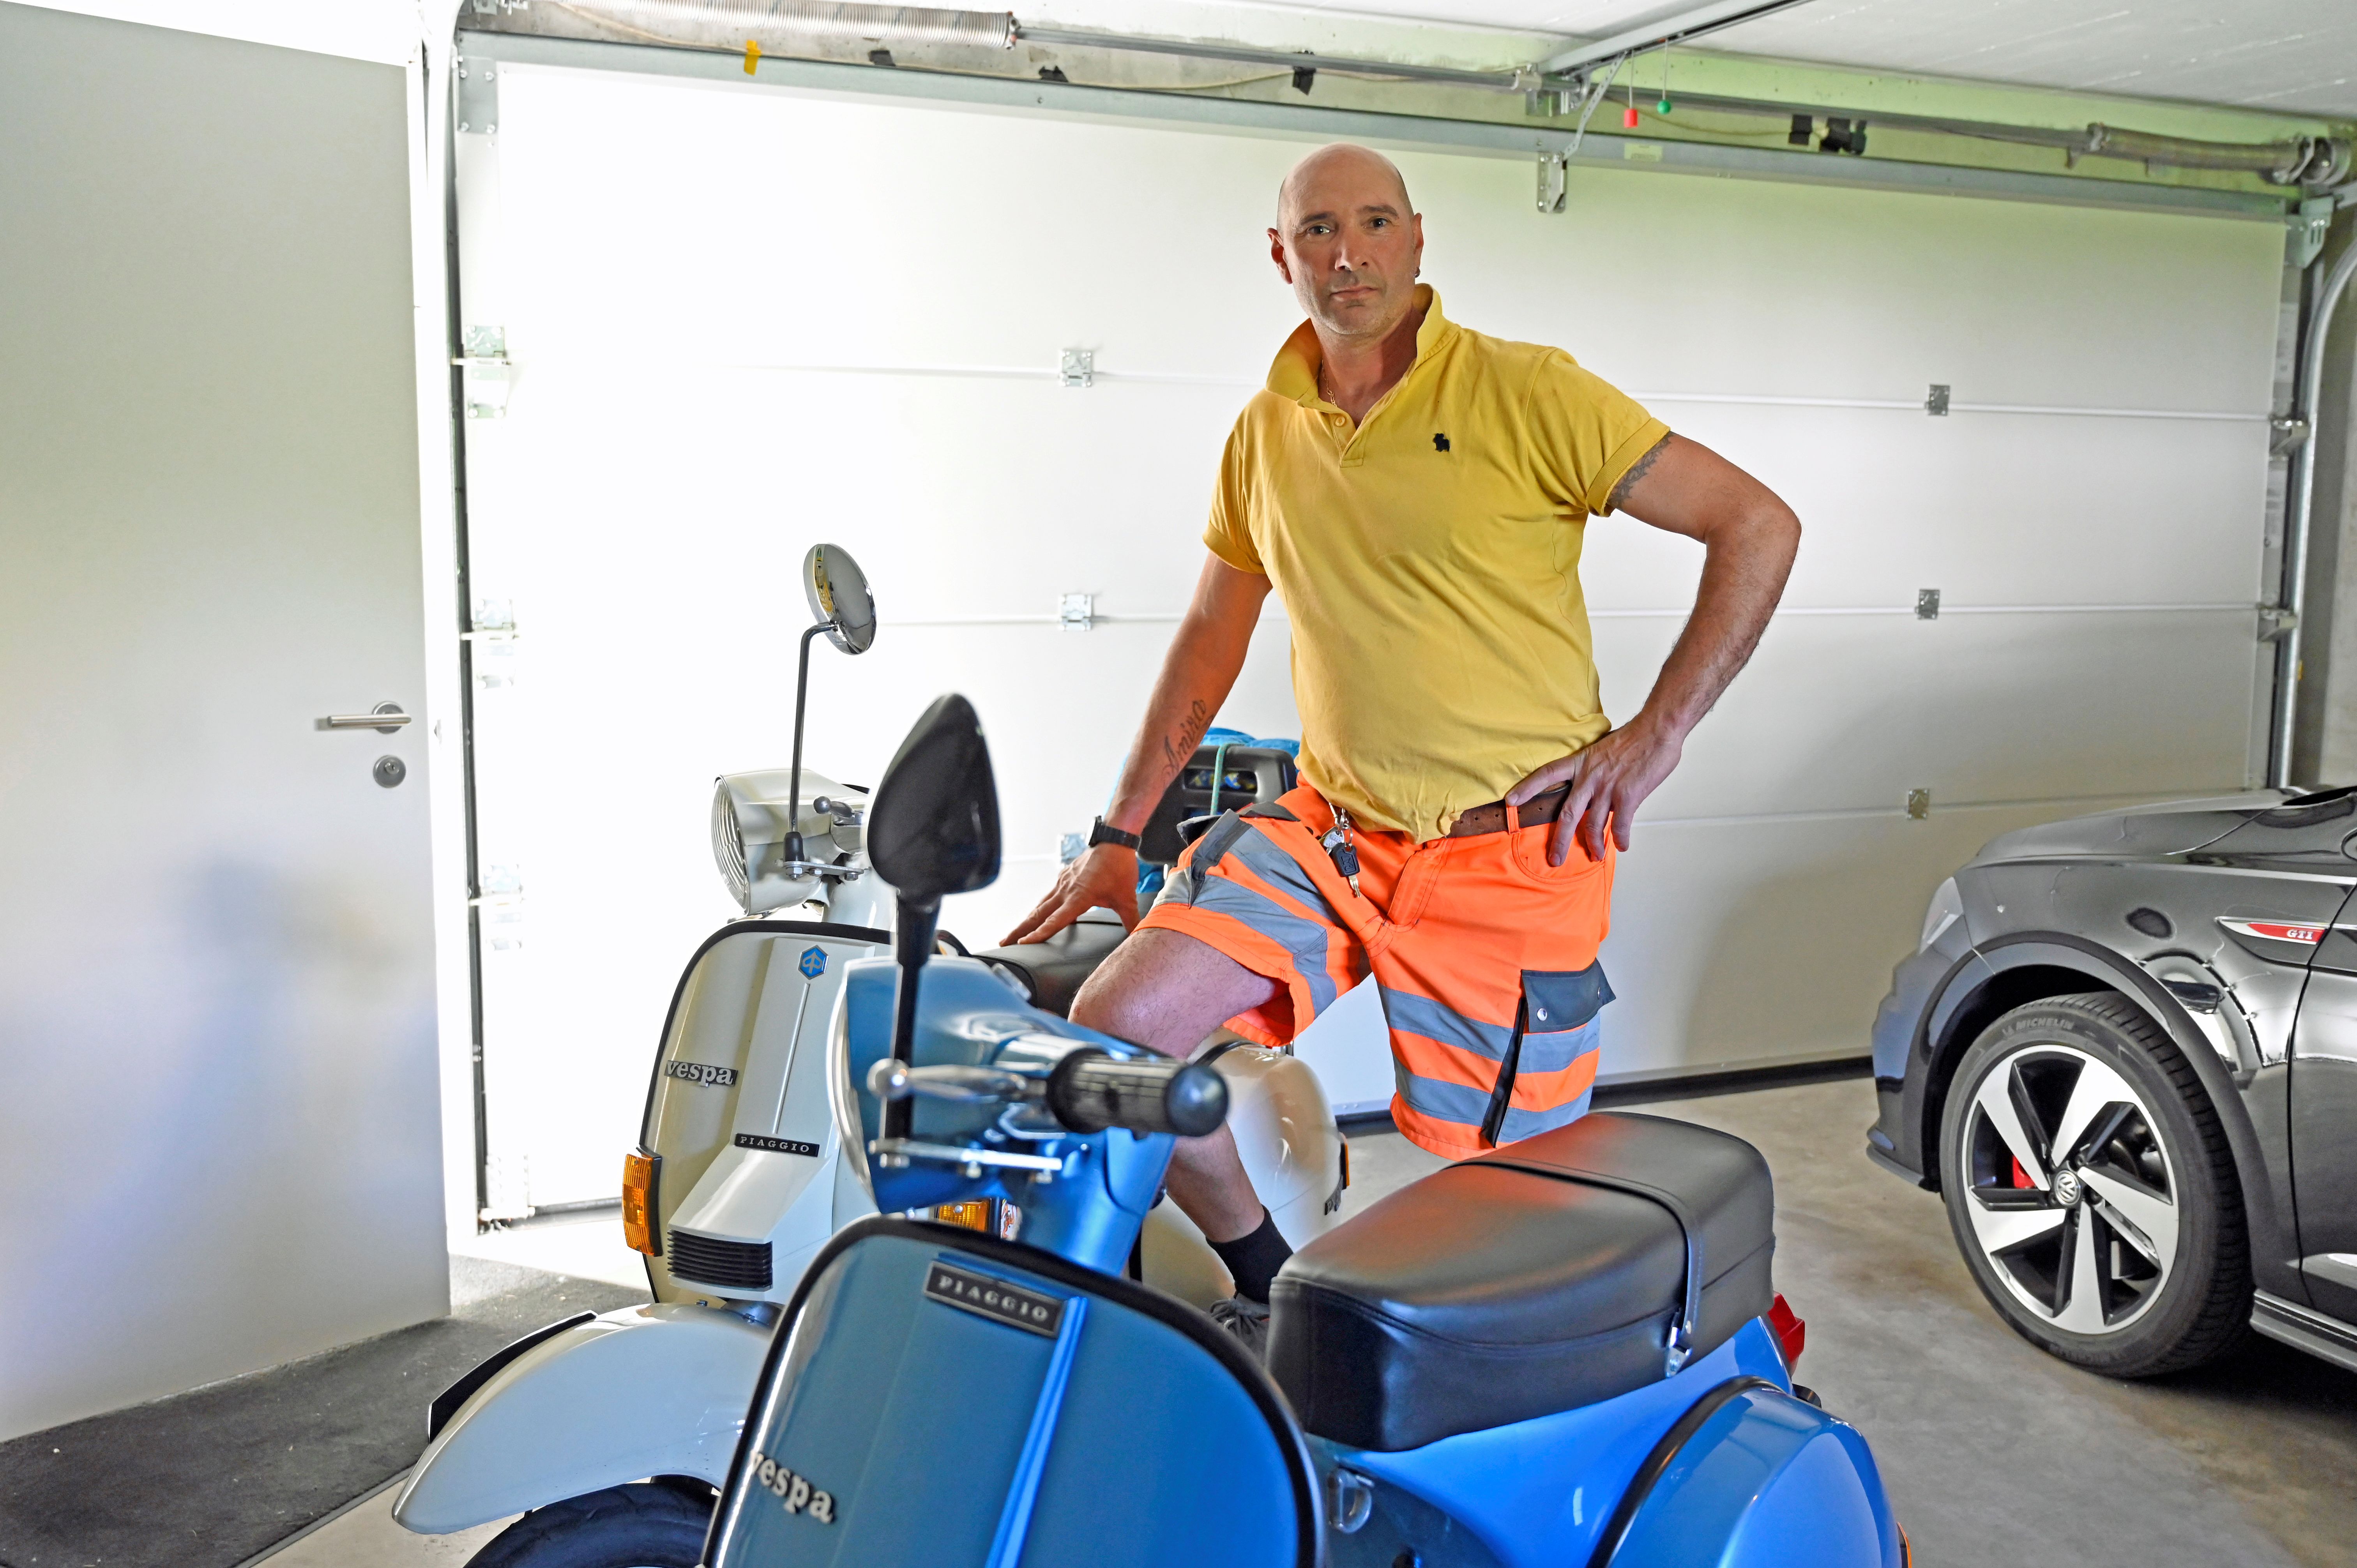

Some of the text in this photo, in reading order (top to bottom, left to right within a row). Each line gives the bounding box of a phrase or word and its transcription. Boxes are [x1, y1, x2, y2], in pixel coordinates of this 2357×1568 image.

[2286, 929, 2313, 939] GTI
[2016, 1018, 2074, 1031] MICHELIN
[666, 1060, 734, 1087] vespa
[740, 1136, 809, 1153] PIAGGIO
[939, 1275, 1049, 1322] PIAGGIO
[750, 1449, 833, 1523] vespa
